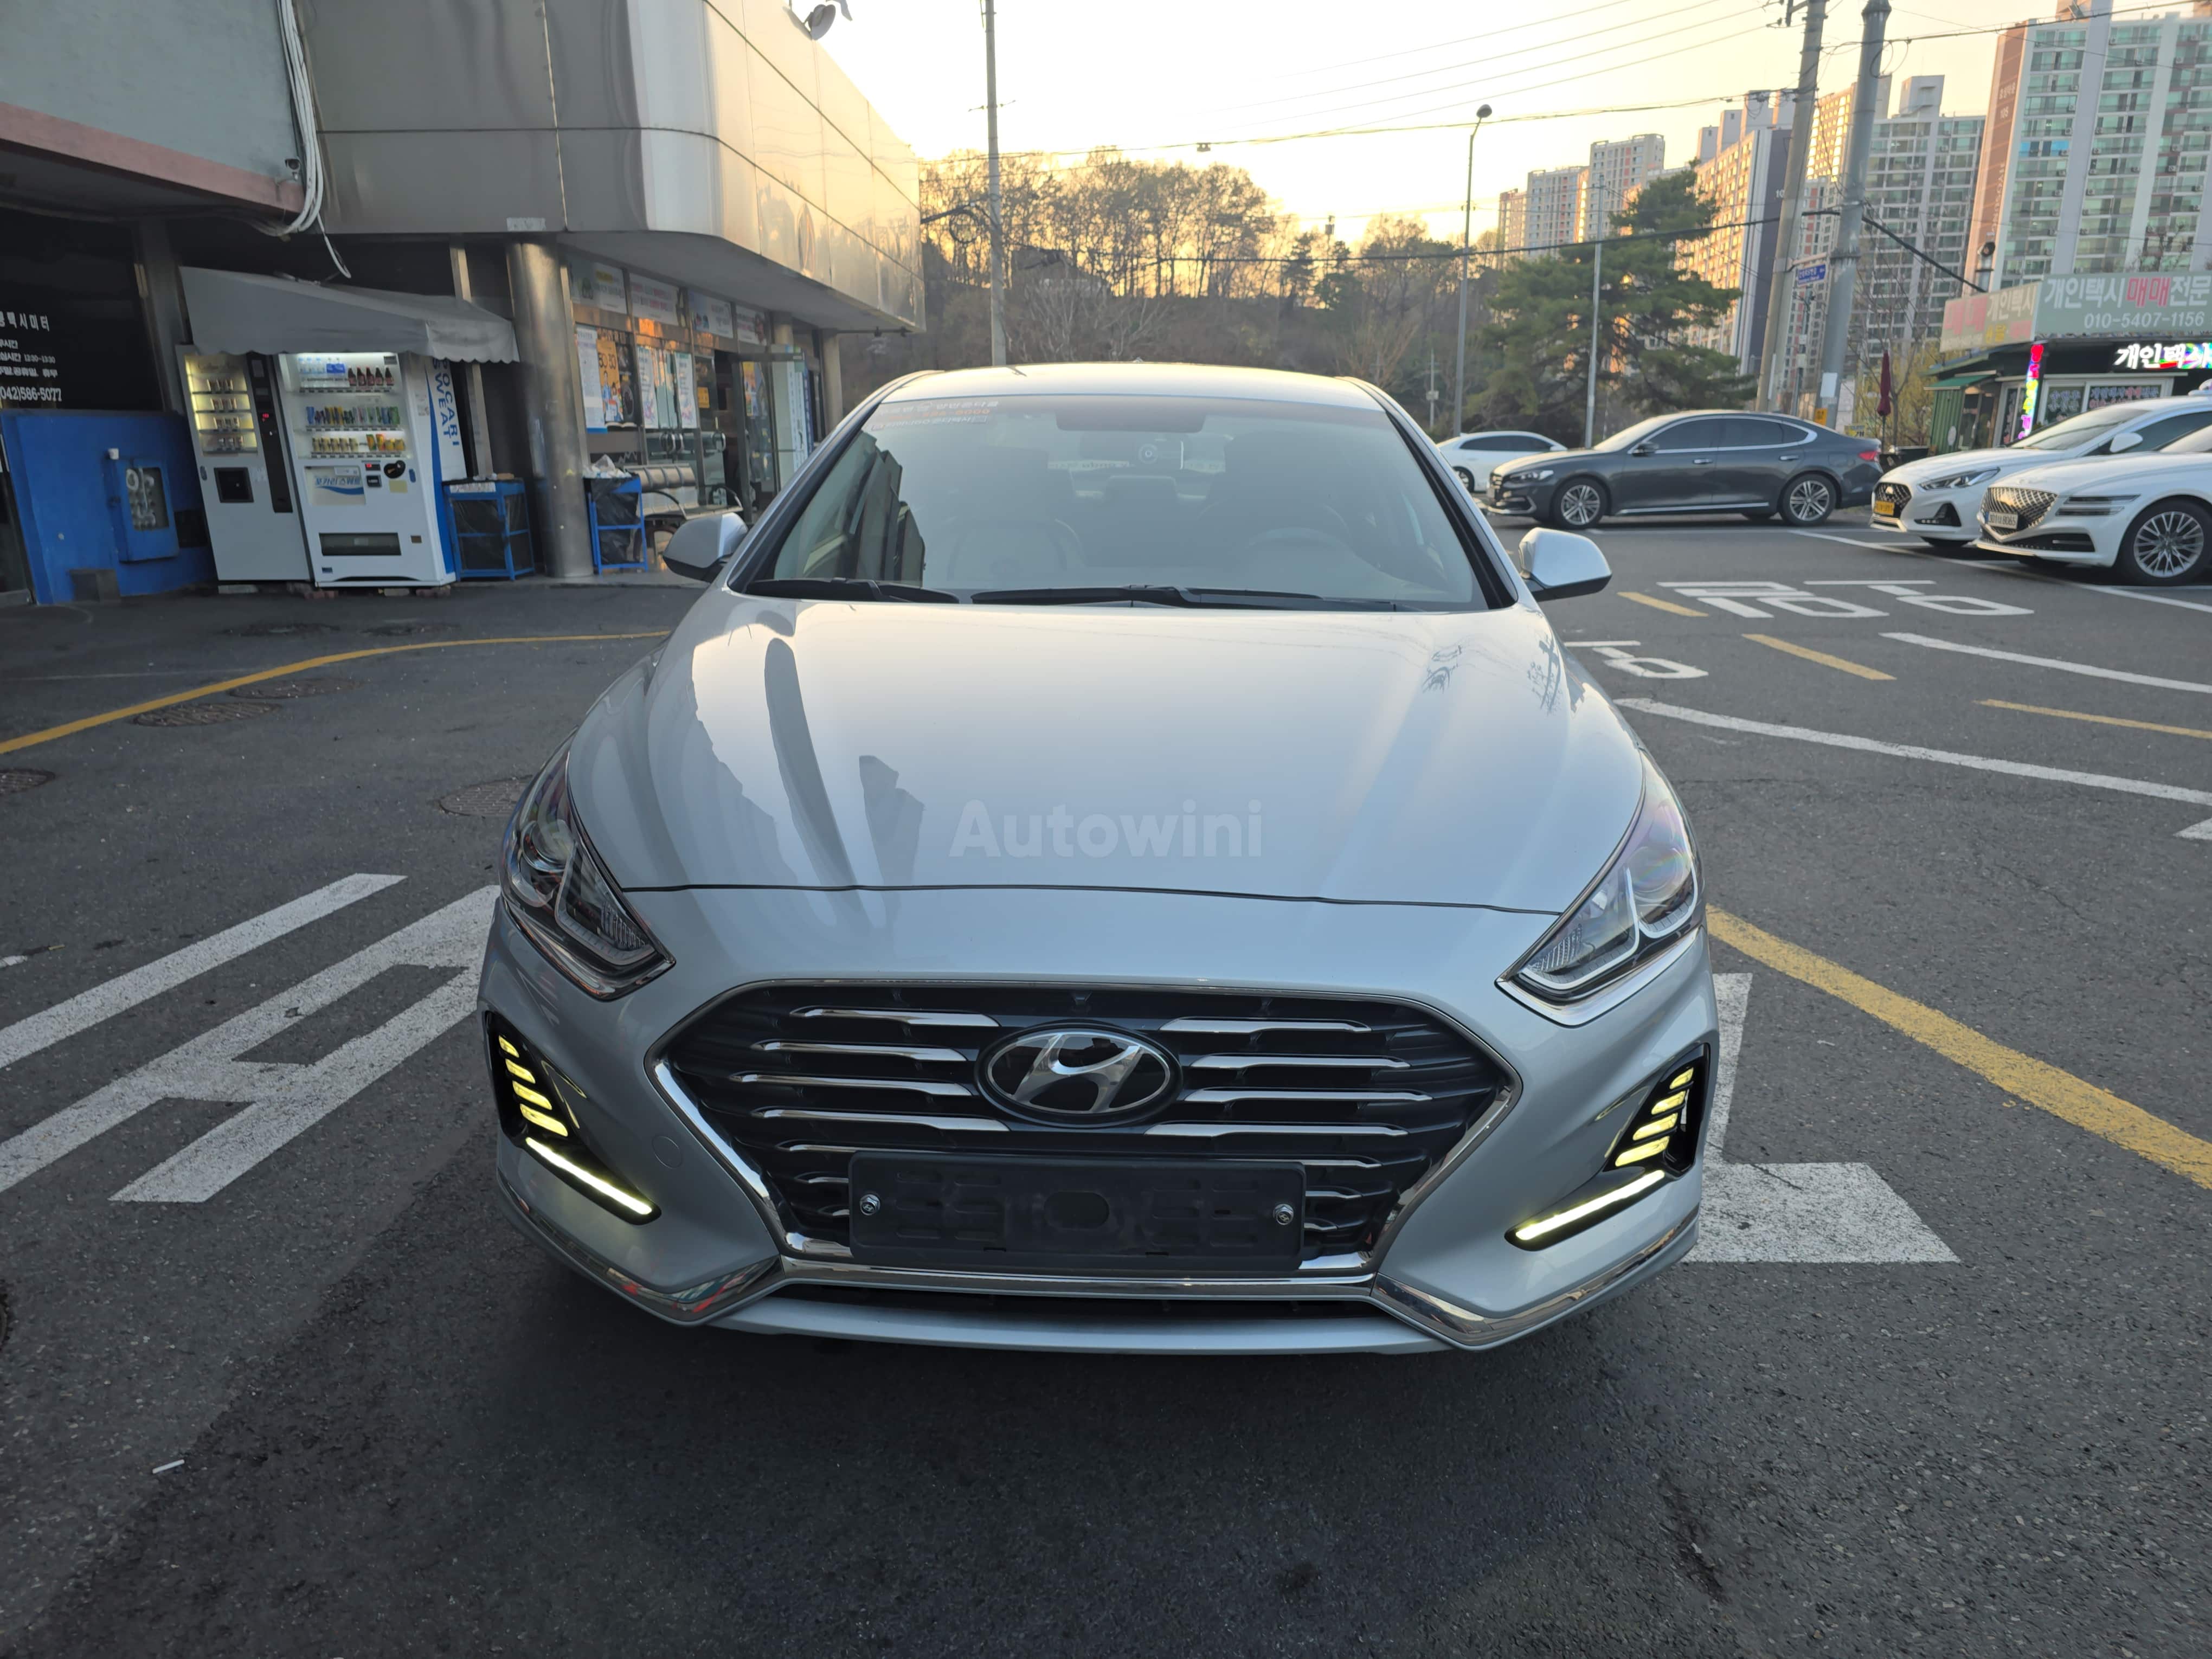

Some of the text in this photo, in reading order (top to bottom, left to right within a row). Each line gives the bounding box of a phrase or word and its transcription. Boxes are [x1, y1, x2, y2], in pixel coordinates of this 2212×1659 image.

[2044, 275, 2211, 309] 개인택시매매전문
[2084, 311, 2205, 329] 010-5407-1156
[2113, 343, 2212, 370] 개인택시
